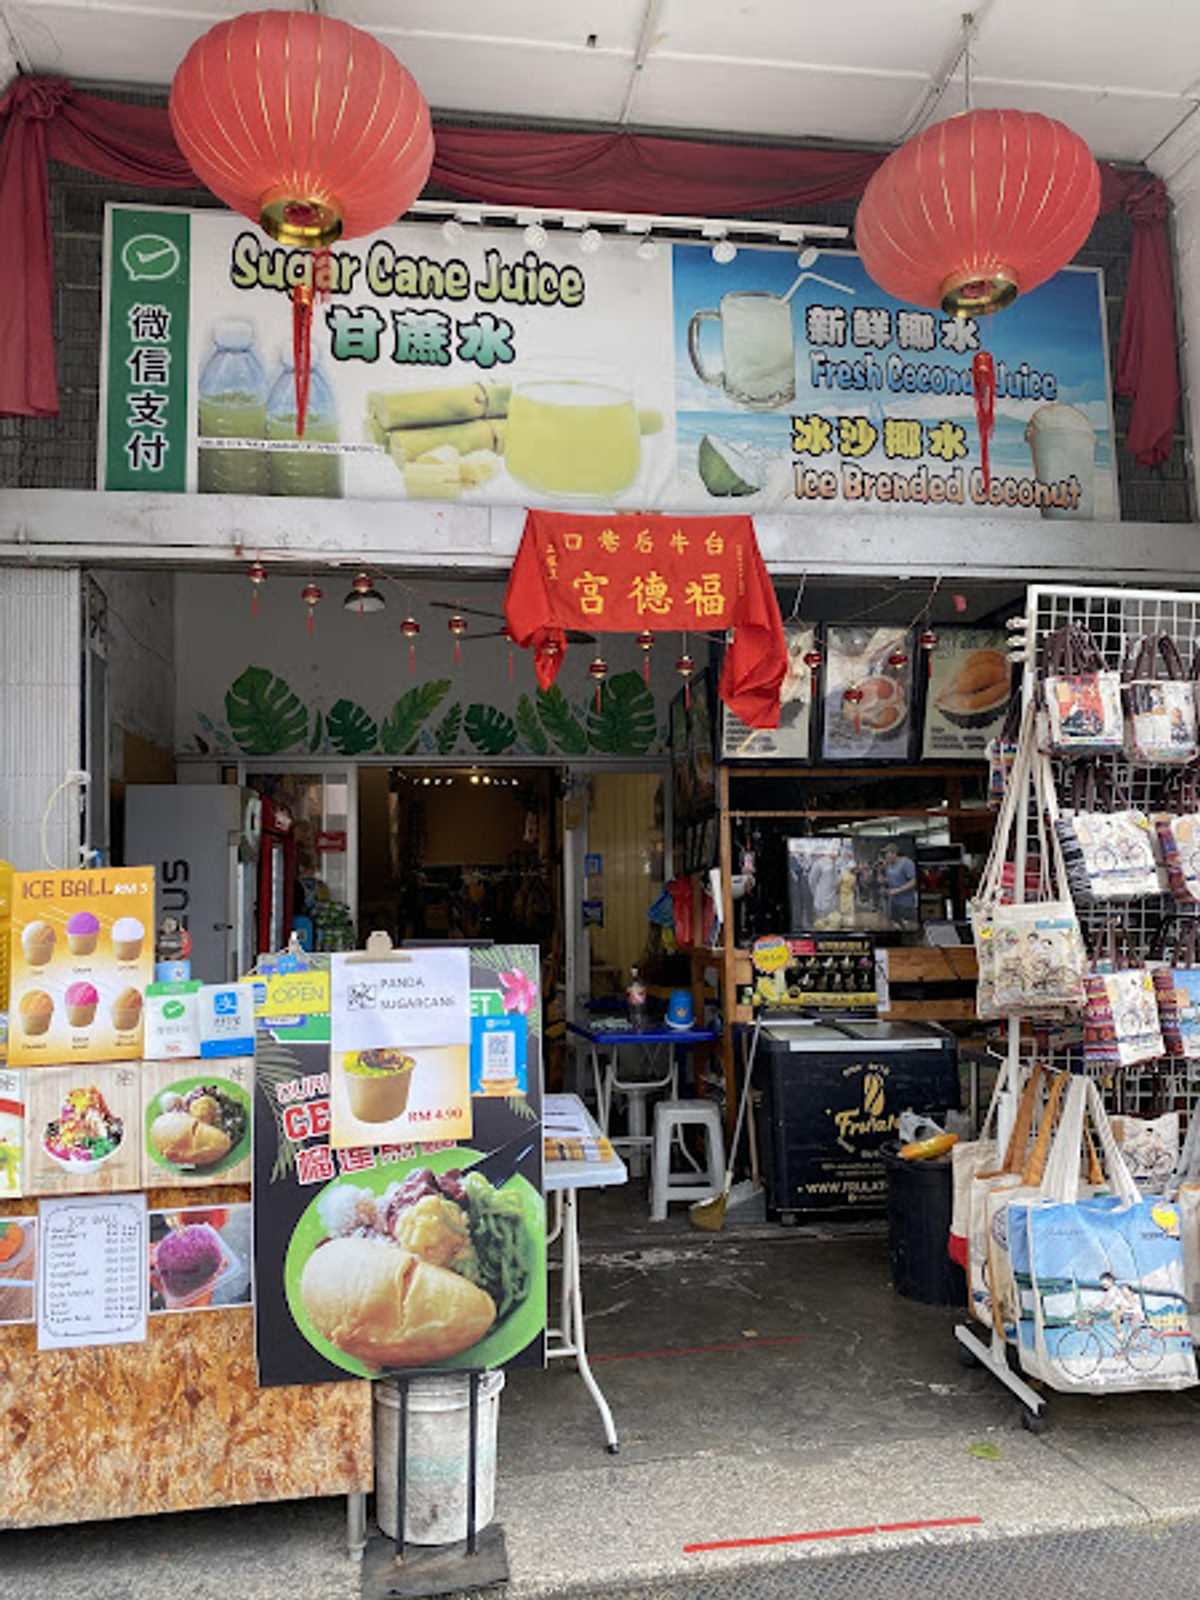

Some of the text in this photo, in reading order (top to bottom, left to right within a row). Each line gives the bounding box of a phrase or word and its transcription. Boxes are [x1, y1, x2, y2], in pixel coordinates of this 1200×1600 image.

[231, 232, 585, 307] Sugar Cane Juice
[326, 304, 515, 368] 甘蔗水
[128, 303, 169, 472] 微信支付
[809, 351, 1057, 400] Fresh Coconu Juice
[790, 414, 969, 461] 冰沙椰水
[793, 460, 1082, 510] Ice Brended Coconut
[22, 880, 55, 900] ICE
[61, 877, 113, 898] BALL
[272, 985, 324, 1004] OPEN
[380, 976, 425, 988] PANDA
